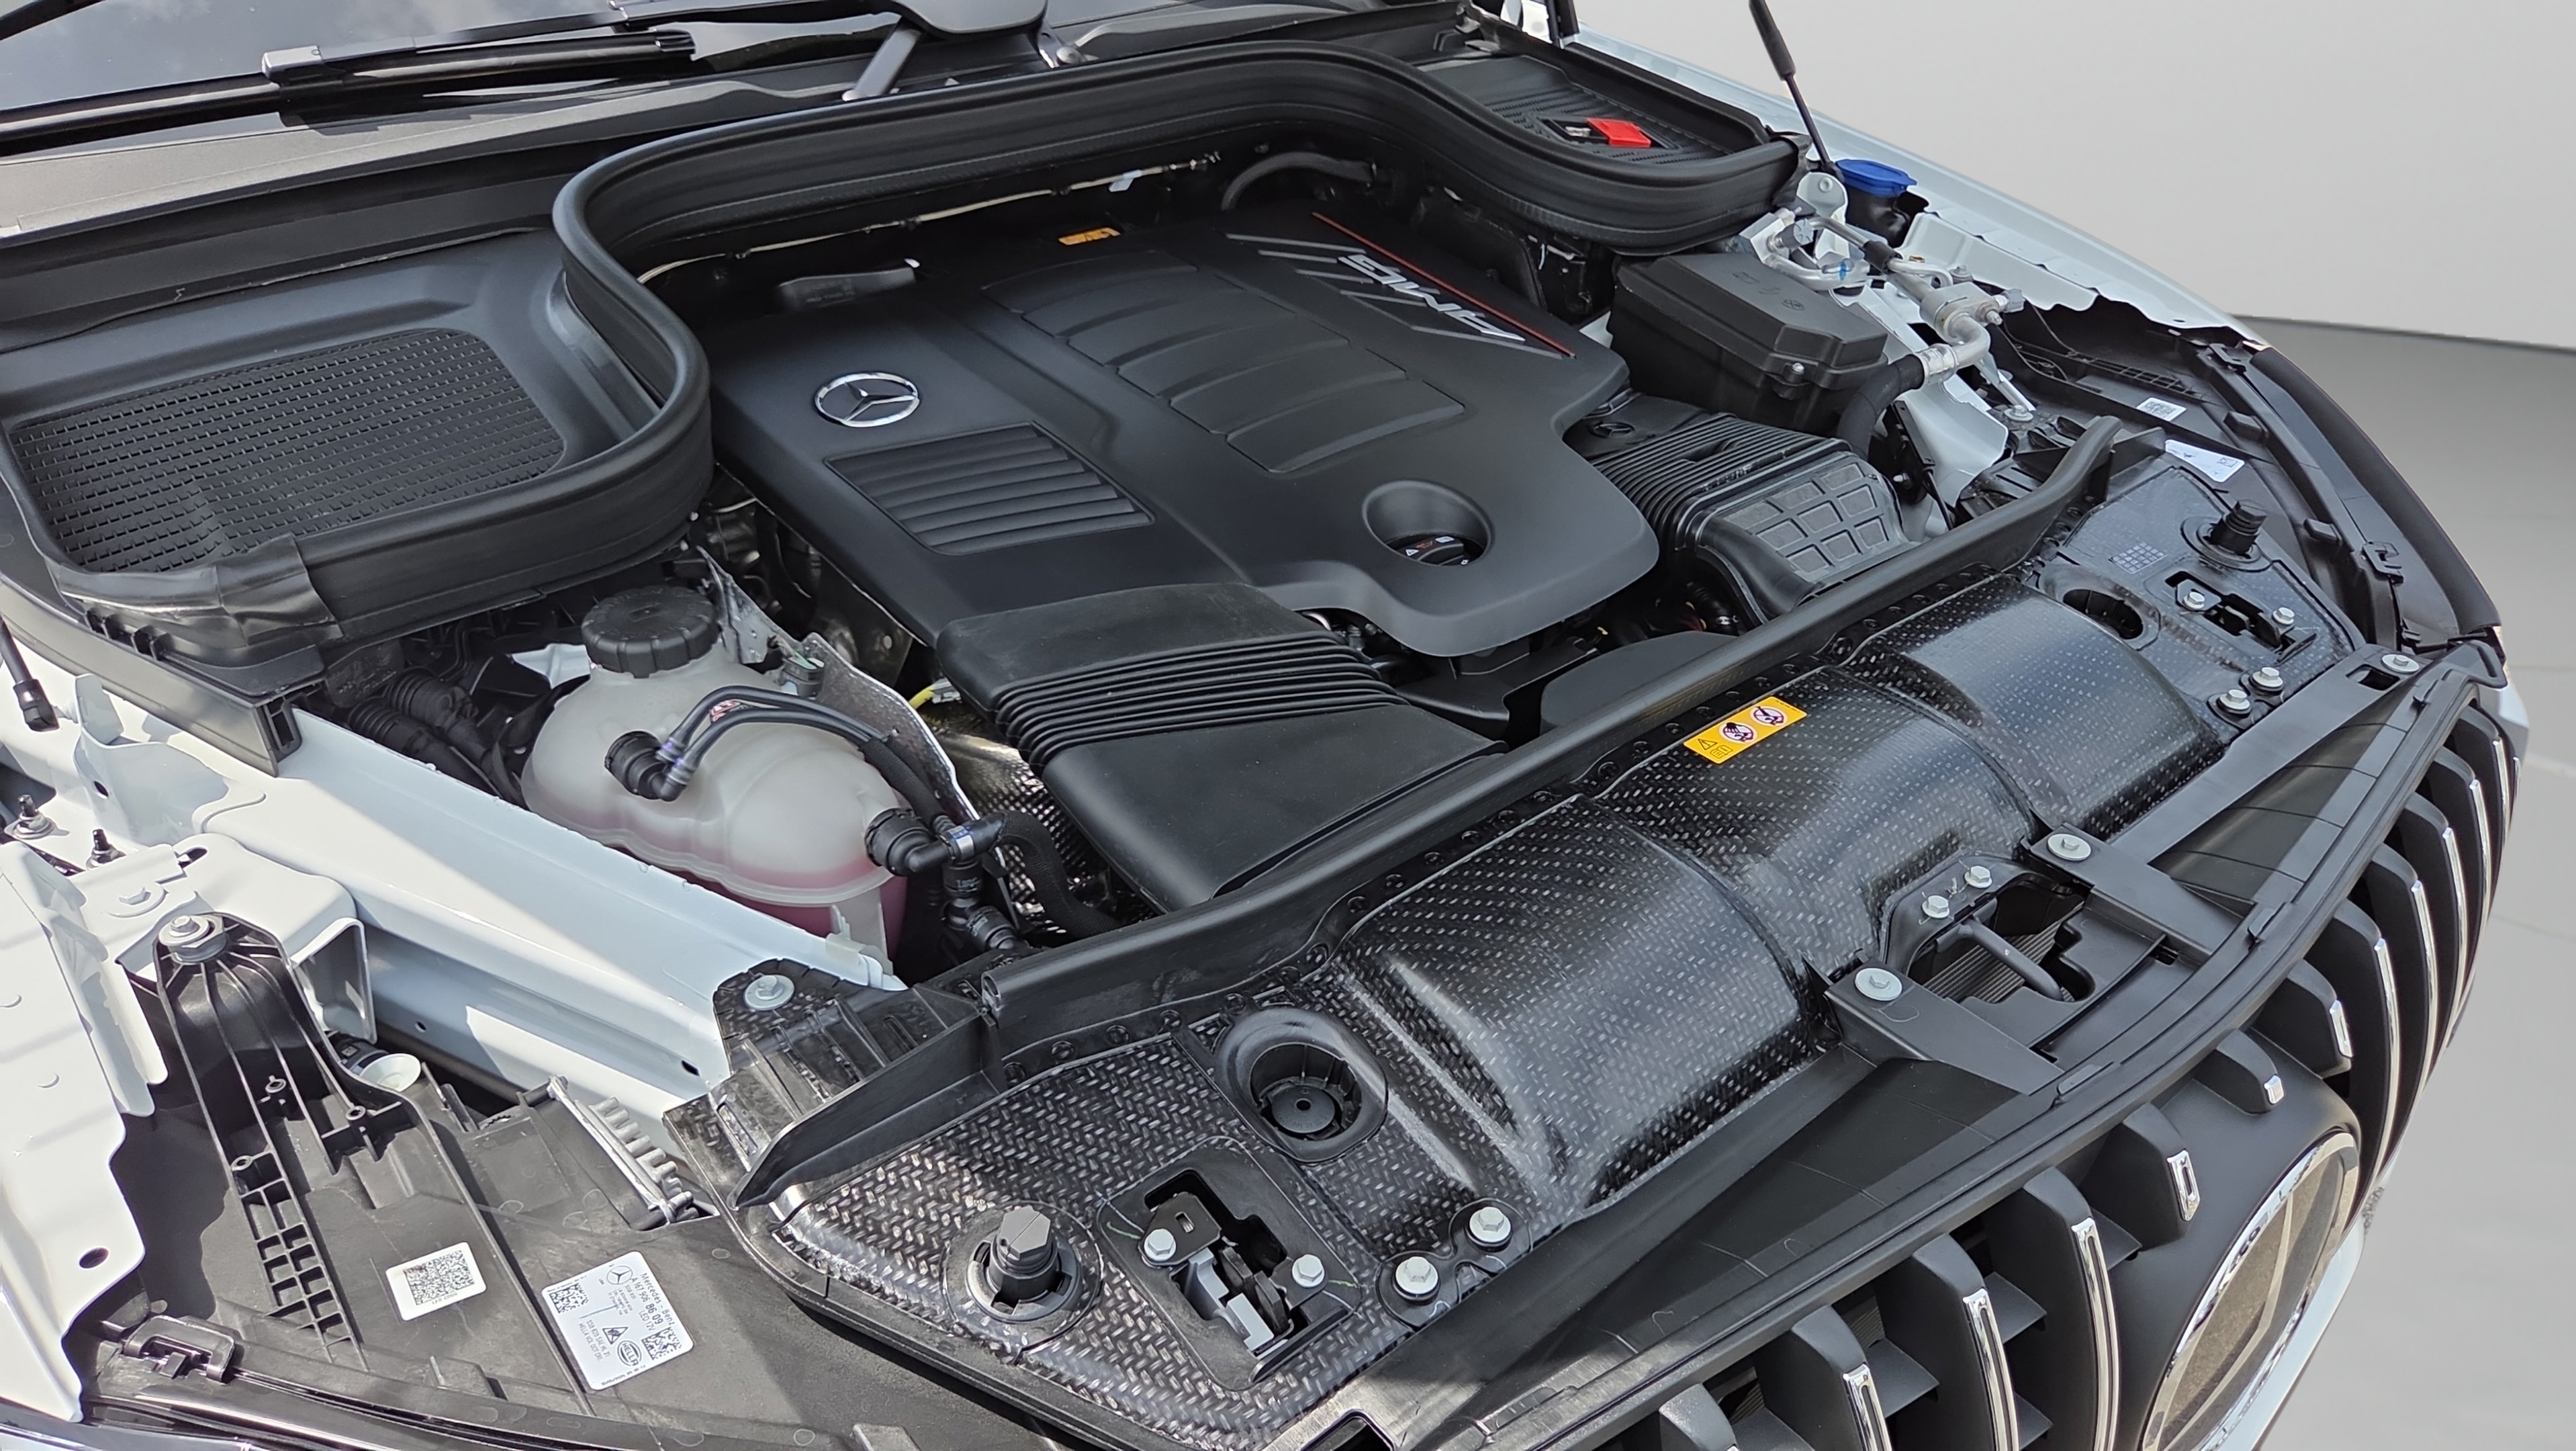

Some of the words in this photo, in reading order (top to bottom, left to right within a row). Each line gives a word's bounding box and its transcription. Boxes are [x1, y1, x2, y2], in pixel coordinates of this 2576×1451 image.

[1338, 255, 1526, 341] AMG
[633, 1281, 645, 1291] 167
[645, 1303, 657, 1314] 86
[651, 1313, 663, 1325] 09
[638, 1309, 650, 1321] LED
[640, 1272, 661, 1304] Mercedes
[661, 1309, 675, 1325] Benz
[623, 1342, 639, 1366] HELLA
